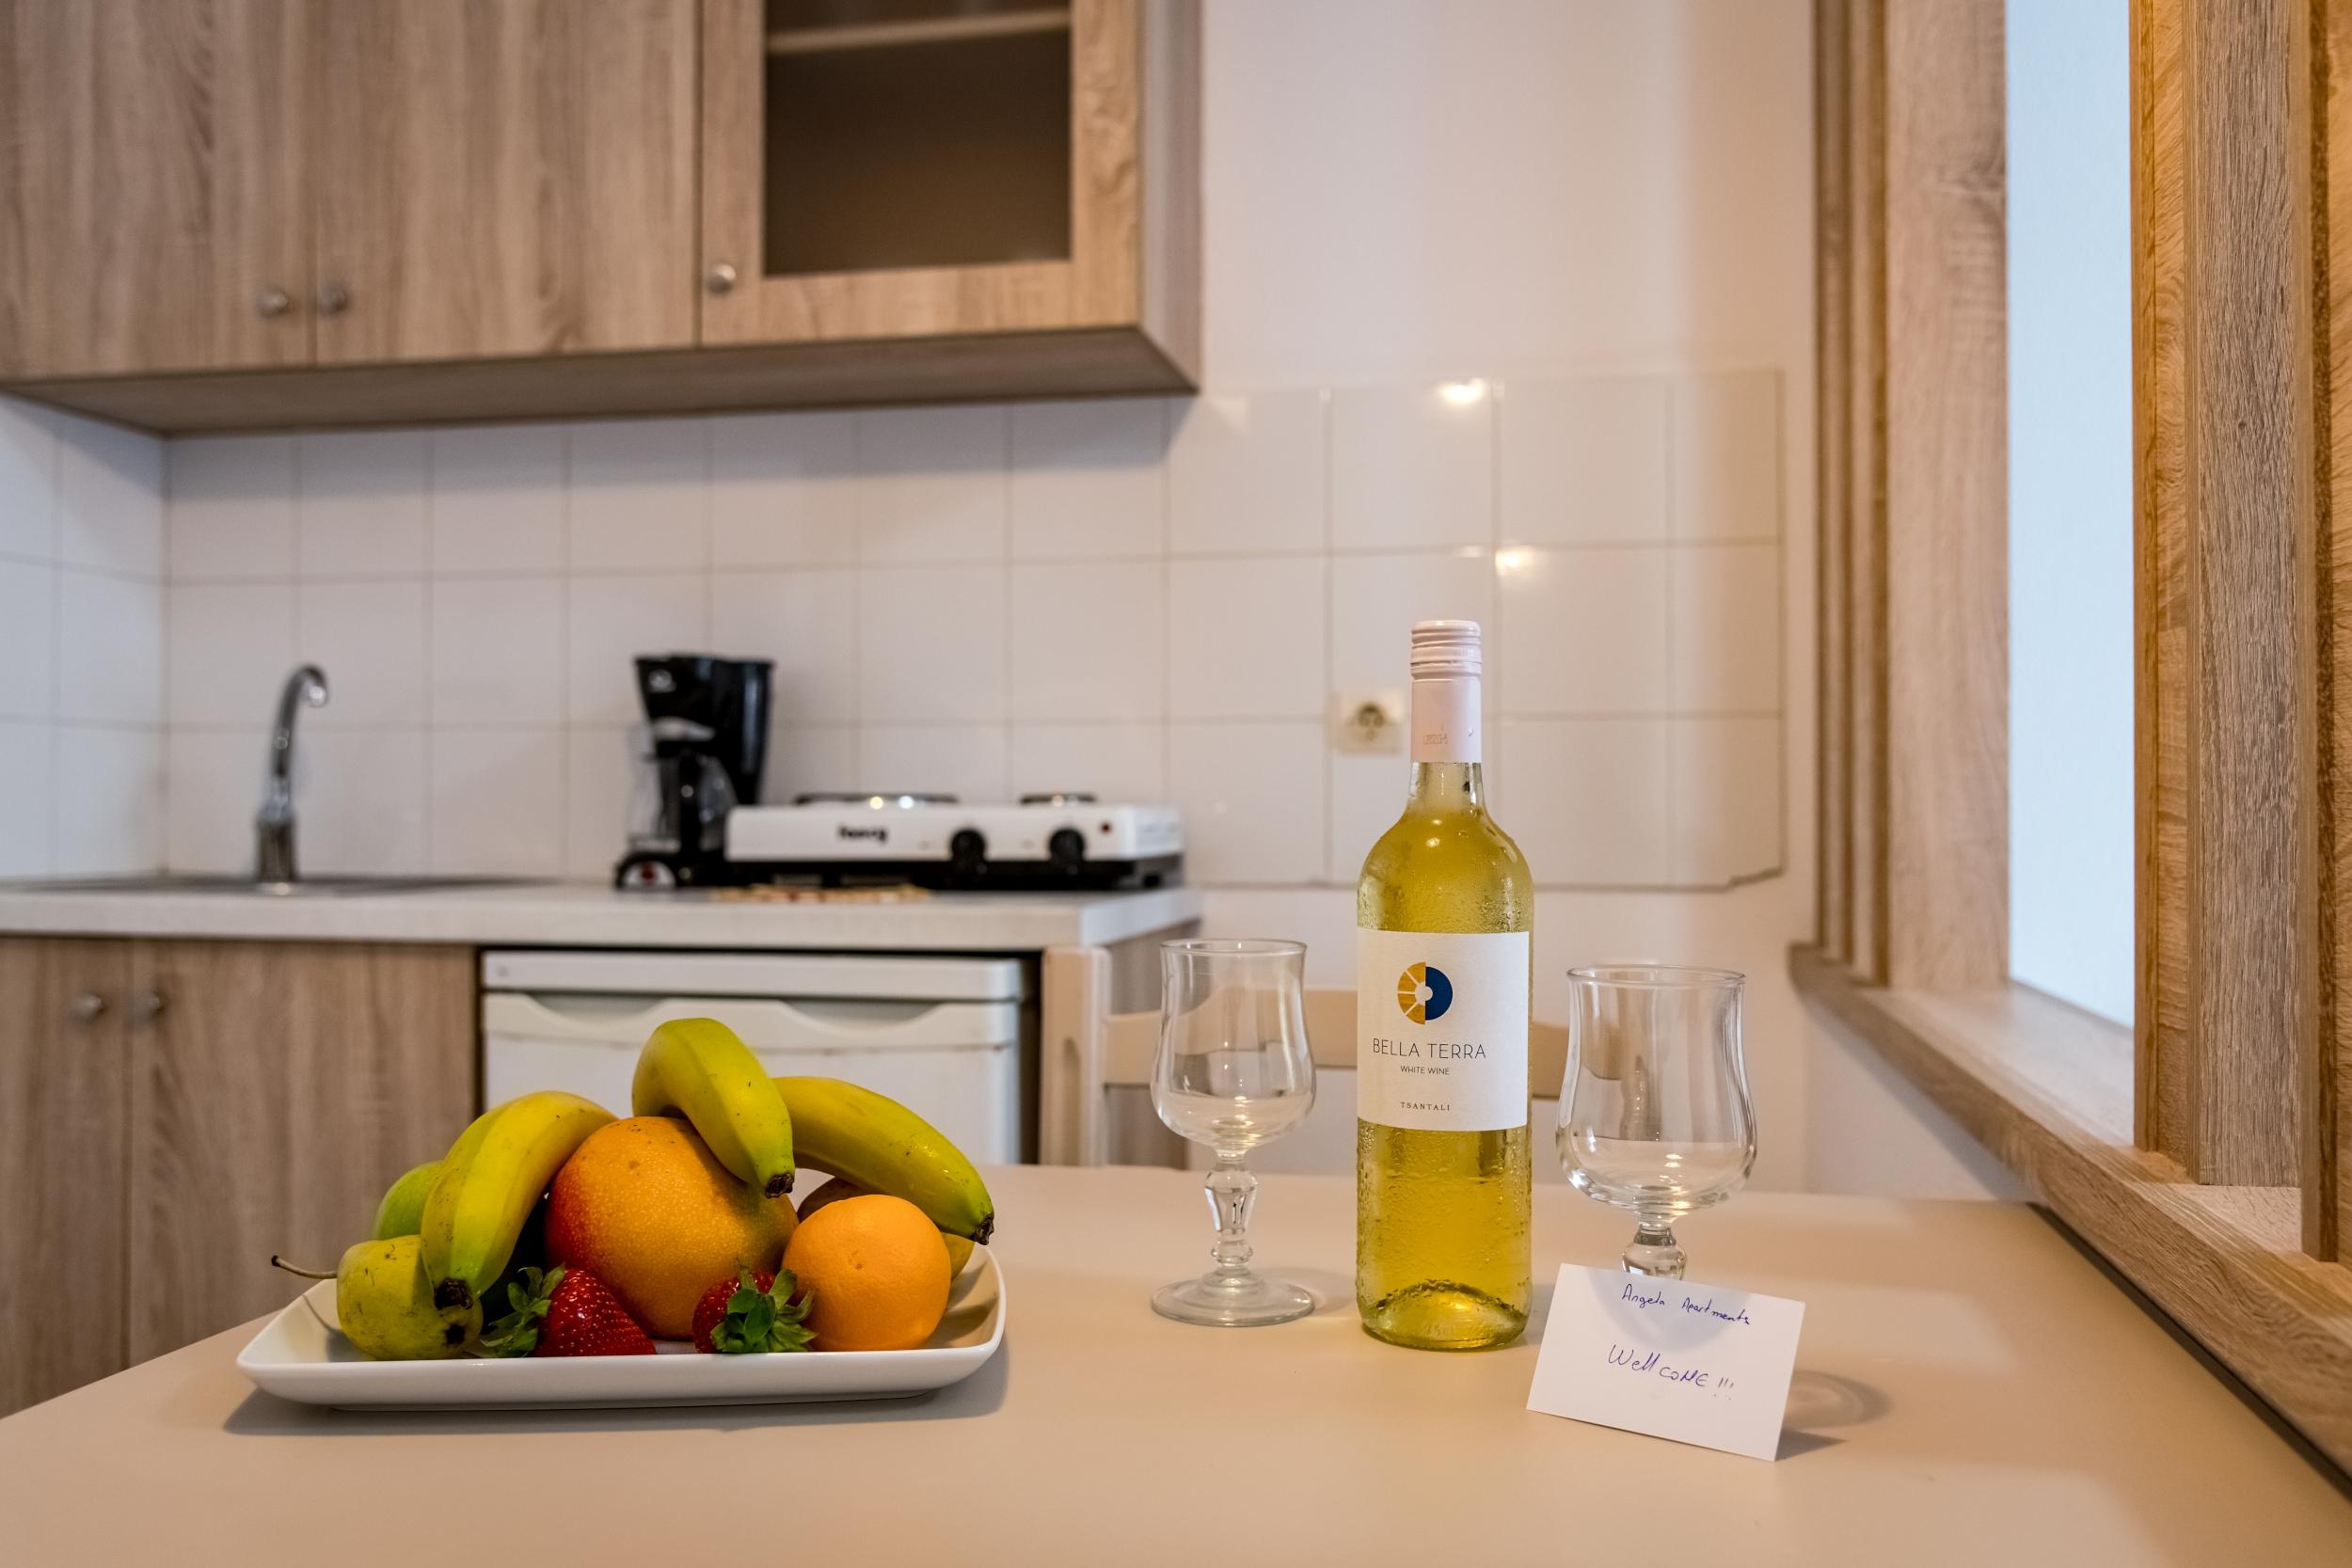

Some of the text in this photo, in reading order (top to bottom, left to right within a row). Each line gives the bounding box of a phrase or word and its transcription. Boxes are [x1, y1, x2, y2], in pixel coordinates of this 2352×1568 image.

[1372, 1037, 1486, 1059] BELLA TERRA
[1400, 1065, 1450, 1075] WHITE WINE
[1400, 1101, 1451, 1112] TSANTALI
[1621, 1283, 1665, 1308] Angela
